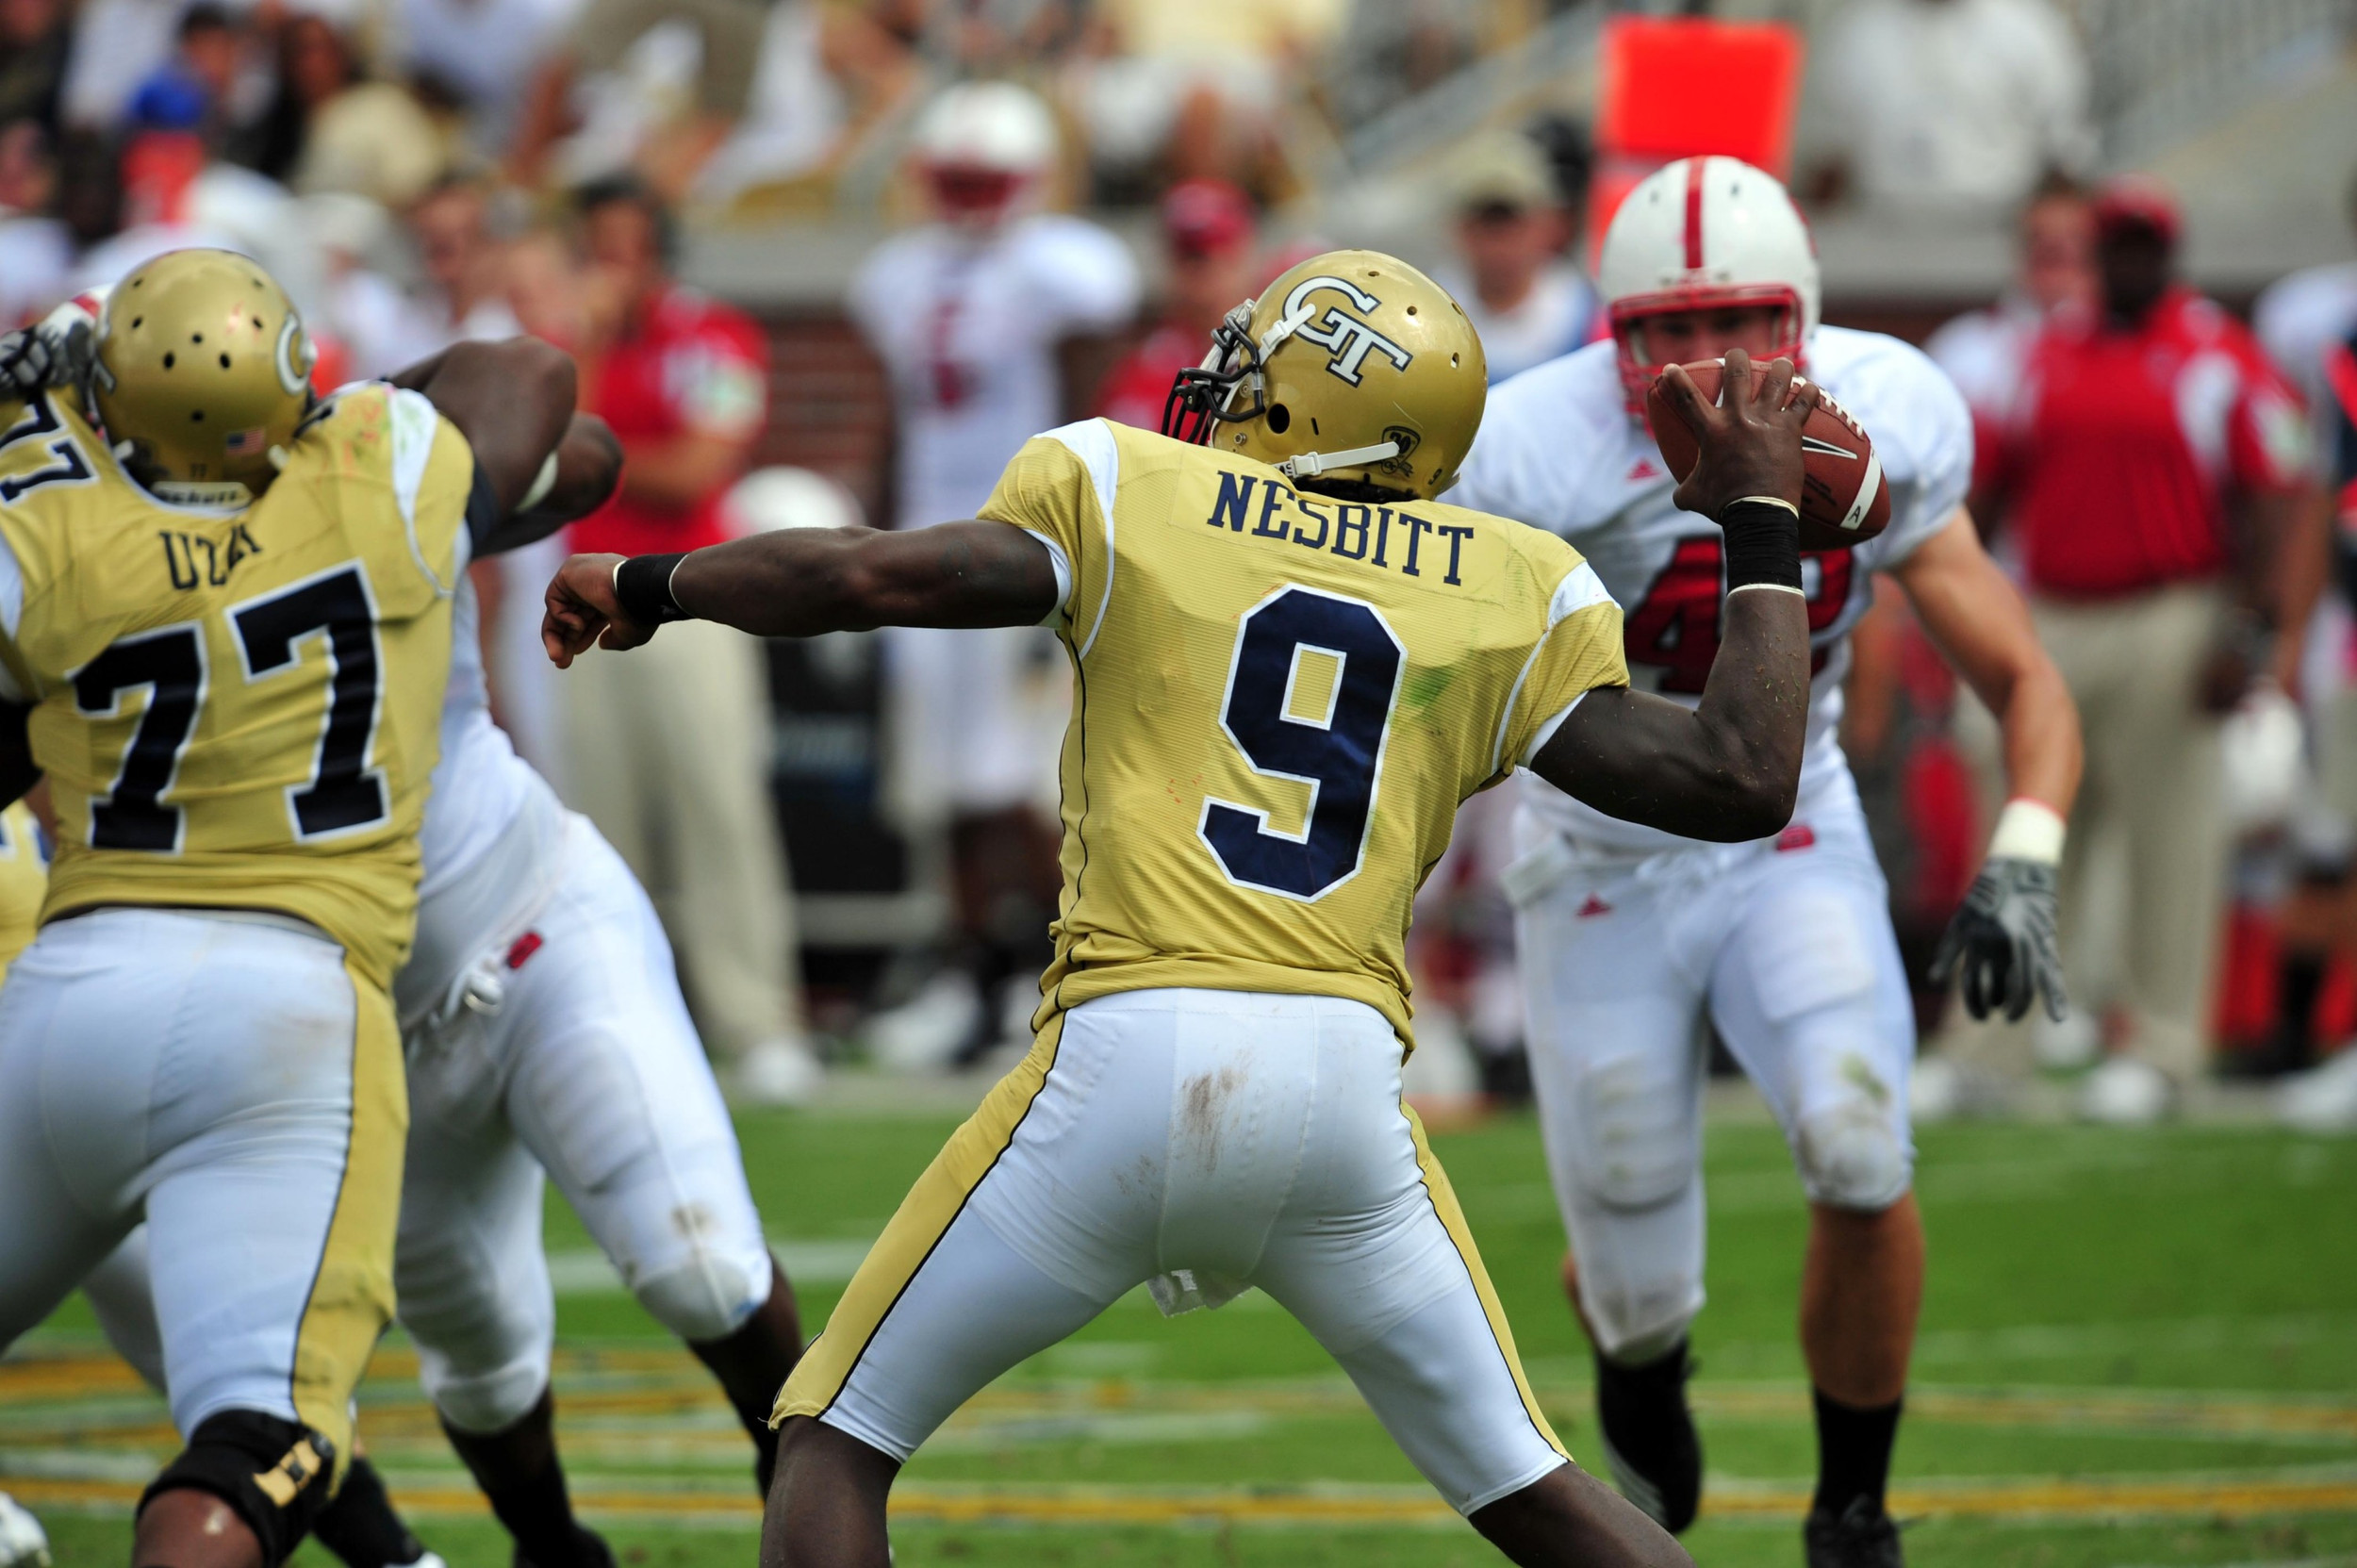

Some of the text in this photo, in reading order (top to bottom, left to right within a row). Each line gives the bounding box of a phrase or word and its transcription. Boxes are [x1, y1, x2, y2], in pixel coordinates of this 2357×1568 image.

[1282, 275, 1413, 388] GT
[1207, 470, 1475, 586] NESBITT
[1848, 504, 1861, 523] A
[64, 557, 391, 857] 77
[1196, 582, 1409, 903] 9
